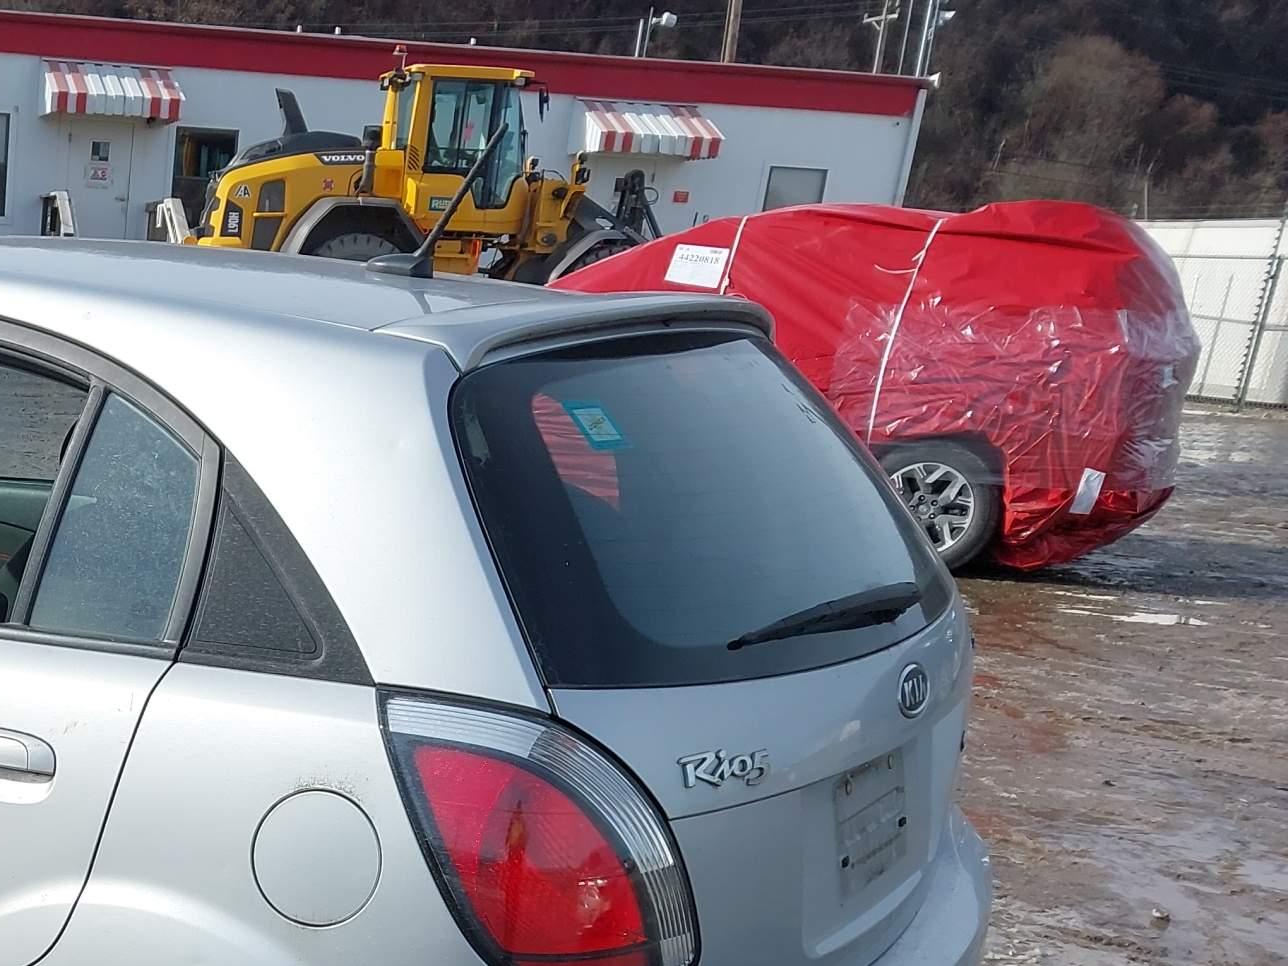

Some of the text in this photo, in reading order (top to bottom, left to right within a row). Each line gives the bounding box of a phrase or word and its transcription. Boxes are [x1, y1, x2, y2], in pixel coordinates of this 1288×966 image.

[321, 154, 365, 162] VOLVO
[678, 252, 721, 265] 44220818
[902, 674, 927, 707] KIA
[677, 748, 769, 789] Rio5
